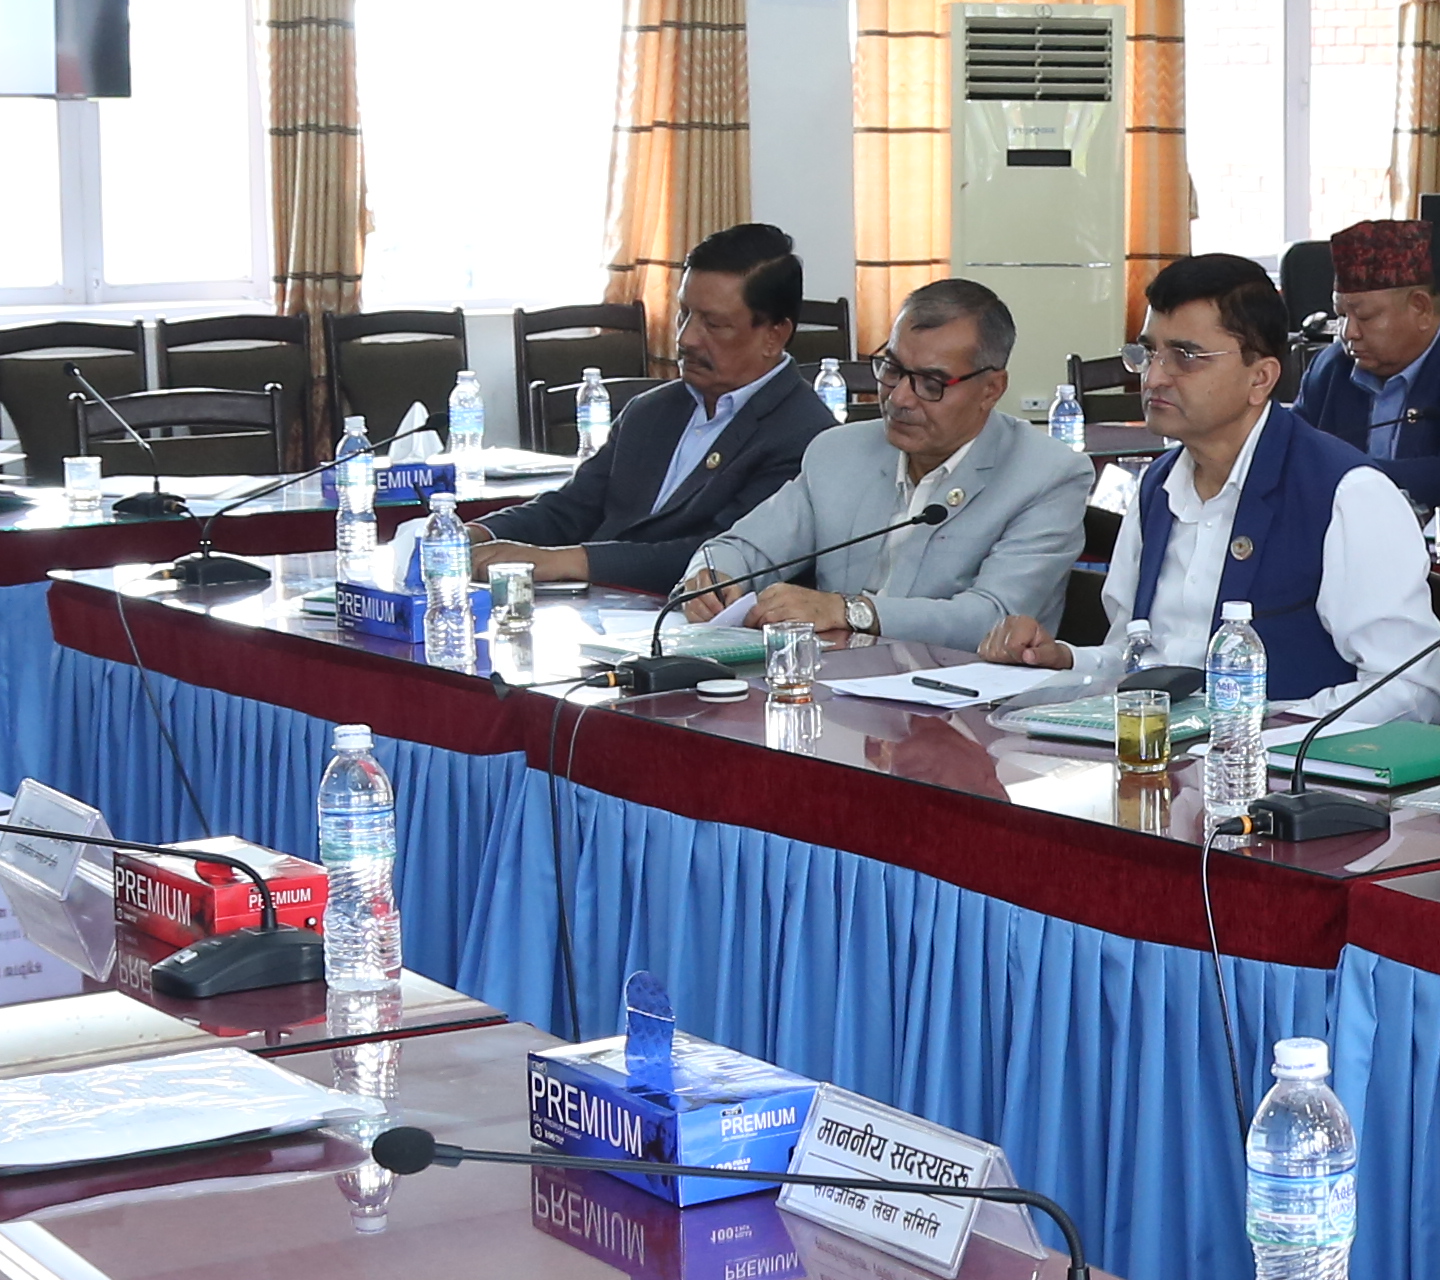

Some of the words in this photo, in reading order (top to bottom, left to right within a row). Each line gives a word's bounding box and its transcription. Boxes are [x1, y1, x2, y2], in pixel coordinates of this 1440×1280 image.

[377, 468, 433, 490] EMIUM
[337, 590, 396, 624] PREMIUM
[115, 866, 192, 927] PREMIUM
[531, 1069, 643, 1158] PREMIUM
[720, 1106, 796, 1137] PREMIUM
[817, 1116, 890, 1163] माननीय
[871, 1193, 900, 1224] लेखा
[902, 1207, 942, 1240] समिति
